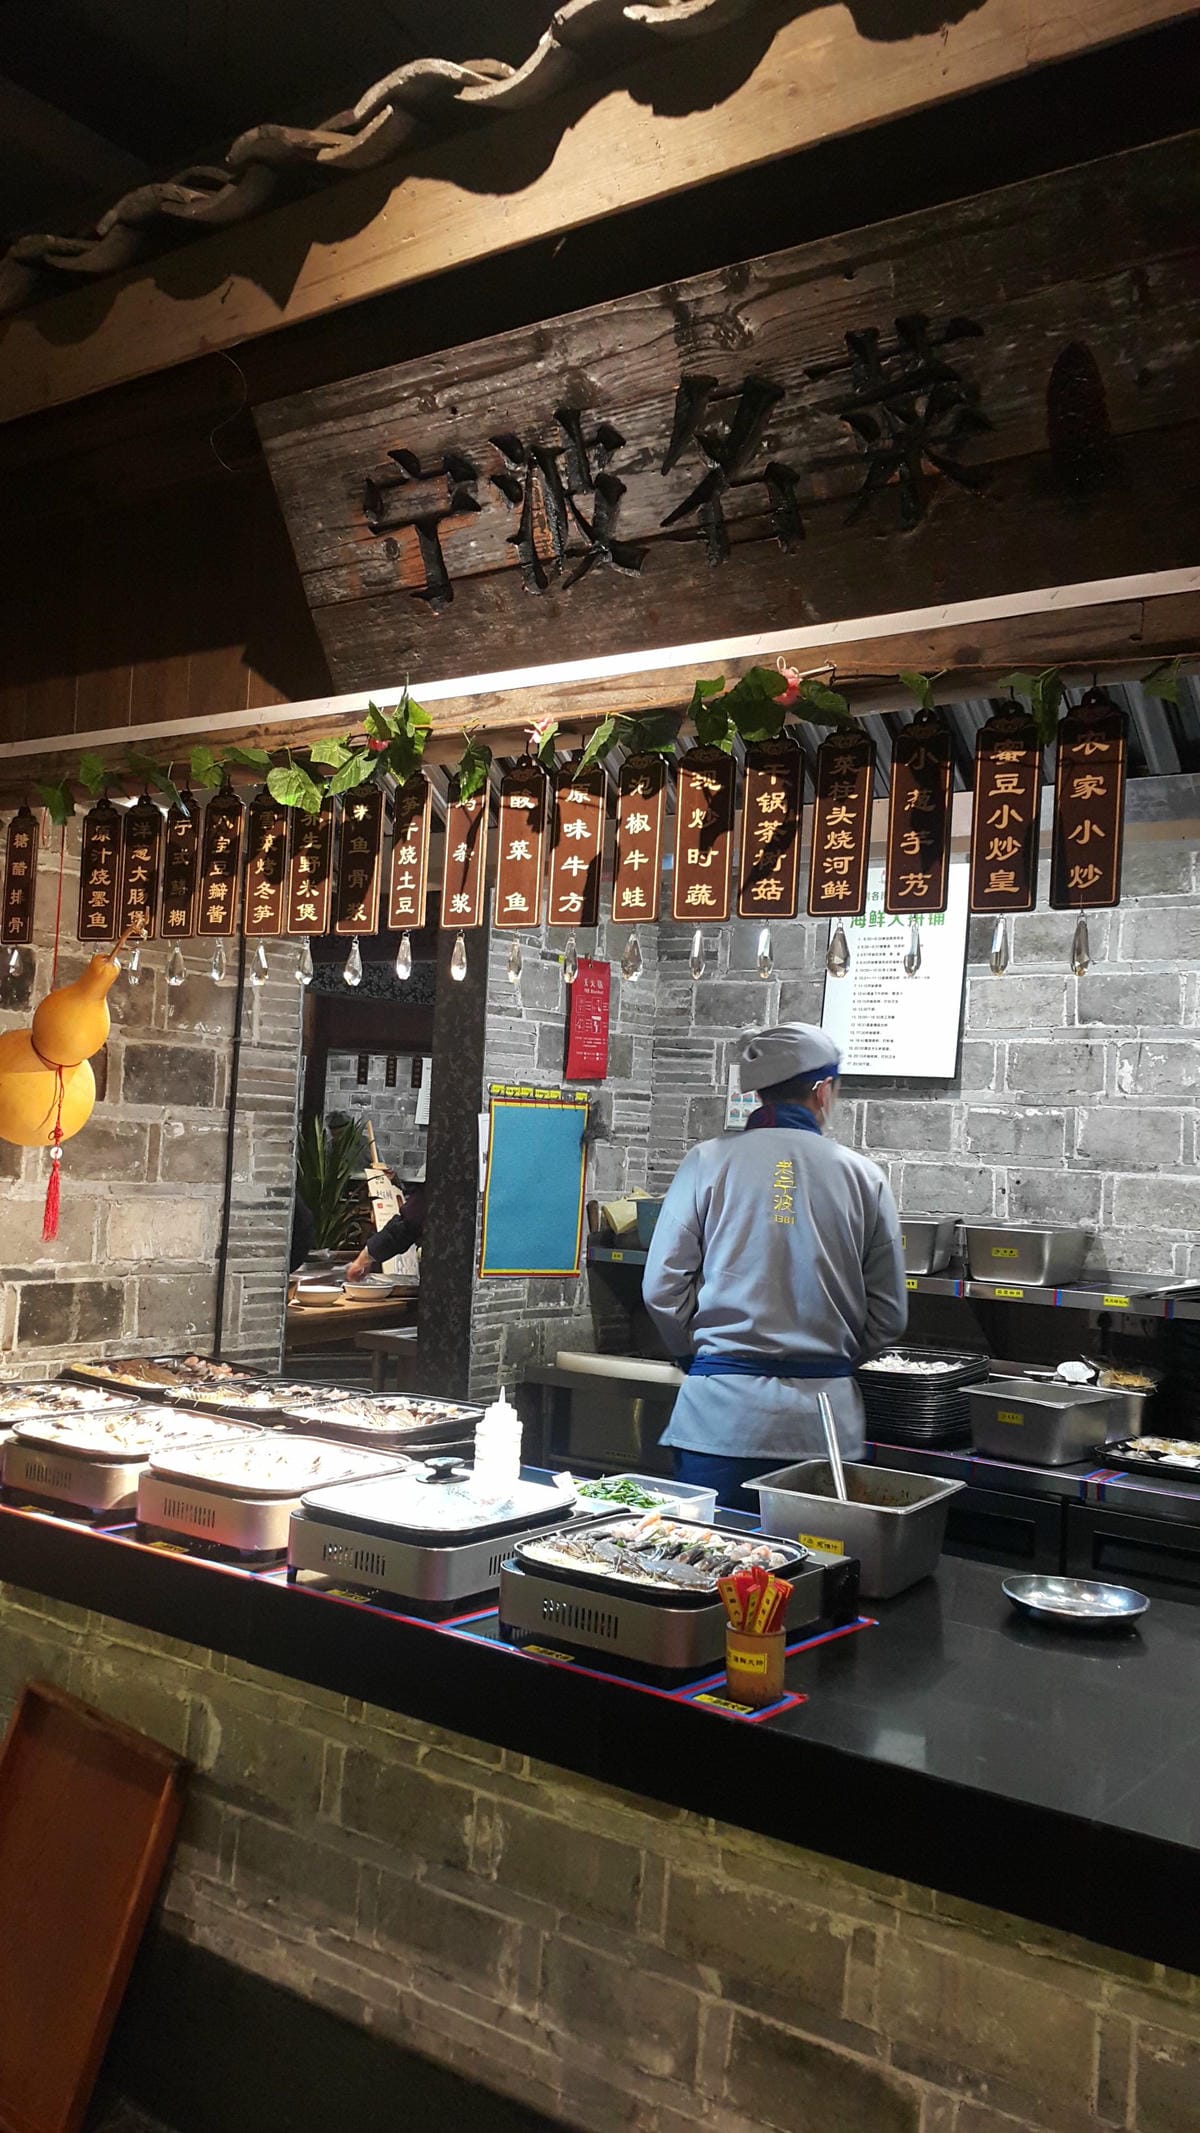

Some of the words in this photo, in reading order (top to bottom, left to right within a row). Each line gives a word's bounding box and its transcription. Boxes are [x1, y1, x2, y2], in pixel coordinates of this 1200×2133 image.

[206, 815, 234, 924] 八宝豆瓣酱
[251, 811, 279, 924] 雪菜烤冬笋
[346, 804, 372, 922] 米鱼骨浆
[395, 796, 421, 915] 笋干烧土豆
[502, 789, 535, 913] 酸菜鱼
[558, 783, 592, 913] 原味牛方
[621, 774, 652, 908] 泡椒牛蛙
[684, 771, 722, 906] 现炒时蔬
[751, 763, 790, 901] 干锅茶树菇
[898, 746, 939, 898] 小葱芋艿
[984, 740, 1026, 894] 蜜豆小炒皇
[1066, 732, 1110, 890] 农家小炒
[8, 832, 30, 935] 糖醋排骨
[86, 825, 113, 929] 原汁烧墨鱼
